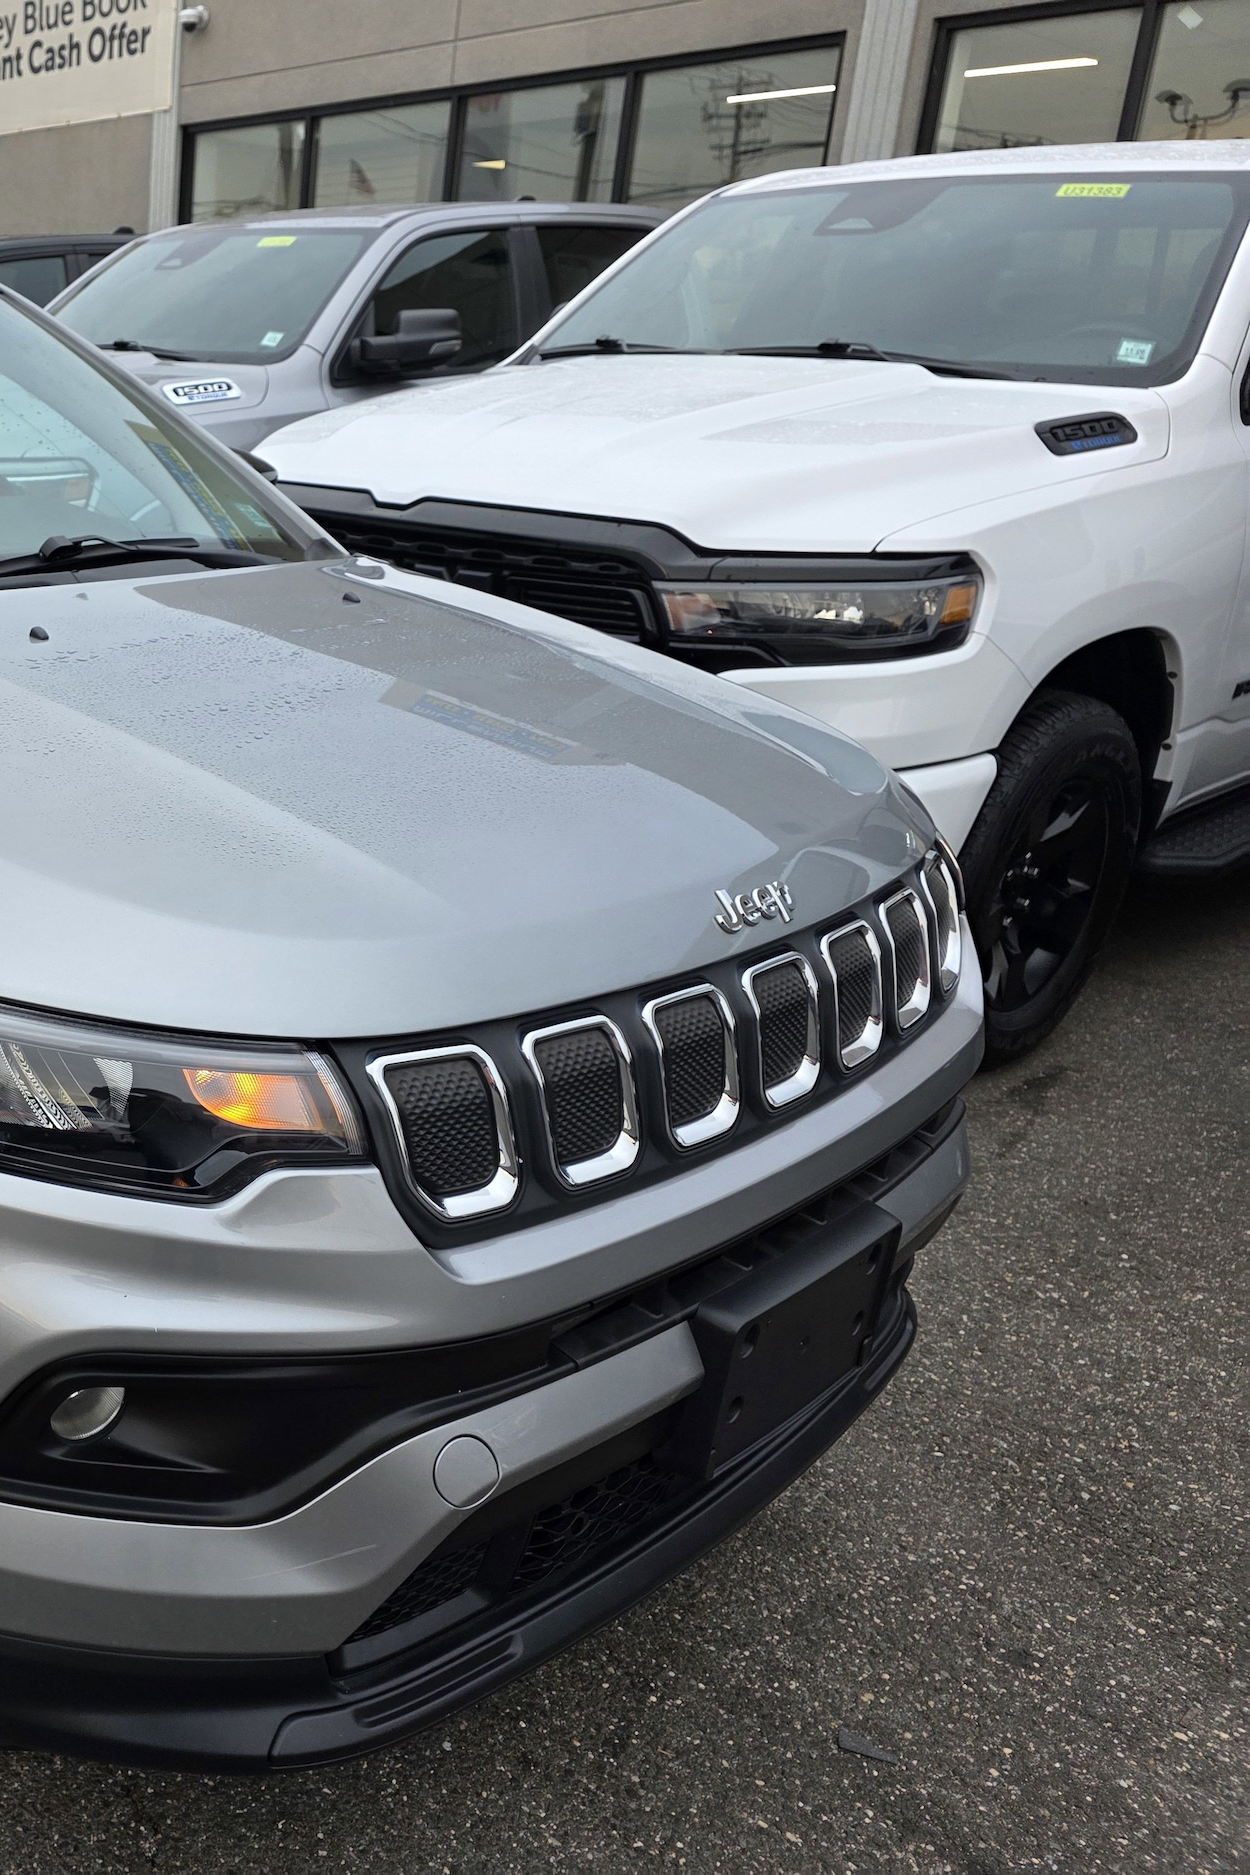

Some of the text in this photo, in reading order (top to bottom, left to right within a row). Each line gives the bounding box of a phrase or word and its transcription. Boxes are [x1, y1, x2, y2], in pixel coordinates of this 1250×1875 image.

[24, 0, 74, 35] Blue
[29, 32, 81, 74] Cash
[88, 21, 151, 63] Offer
[1062, 186, 1123, 197] U31383
[174, 382, 231, 397] 1500
[1052, 419, 1120, 441] 1500
[714, 881, 794, 934] Jeep
